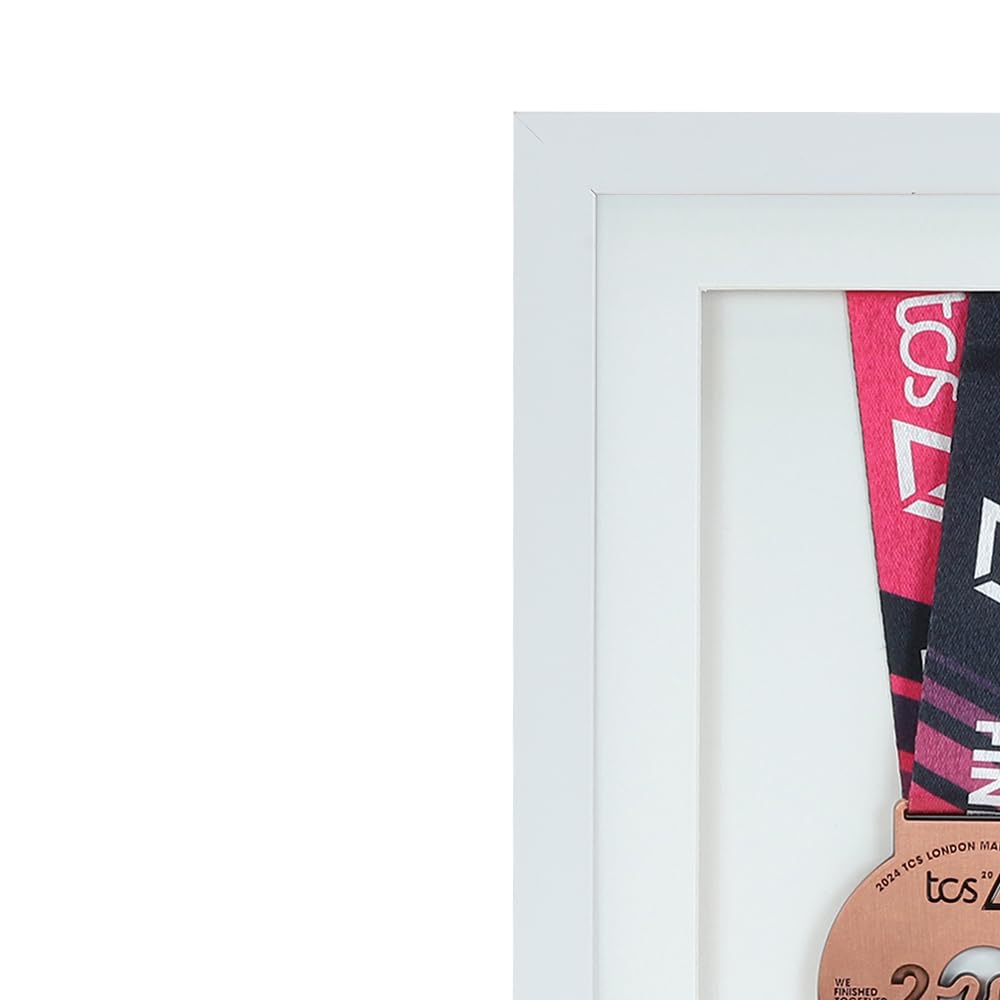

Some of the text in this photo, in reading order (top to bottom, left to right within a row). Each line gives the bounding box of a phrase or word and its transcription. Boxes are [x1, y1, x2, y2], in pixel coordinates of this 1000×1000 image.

[875, 868, 901, 892] 2024
[901, 855, 924, 872] TCS
[926, 841, 976, 861] LONDON
[981, 871, 994, 879] 20
[926, 870, 978, 904] tcs
[834, 978, 851, 987] WE
[834, 987, 878, 997] FINISHED
